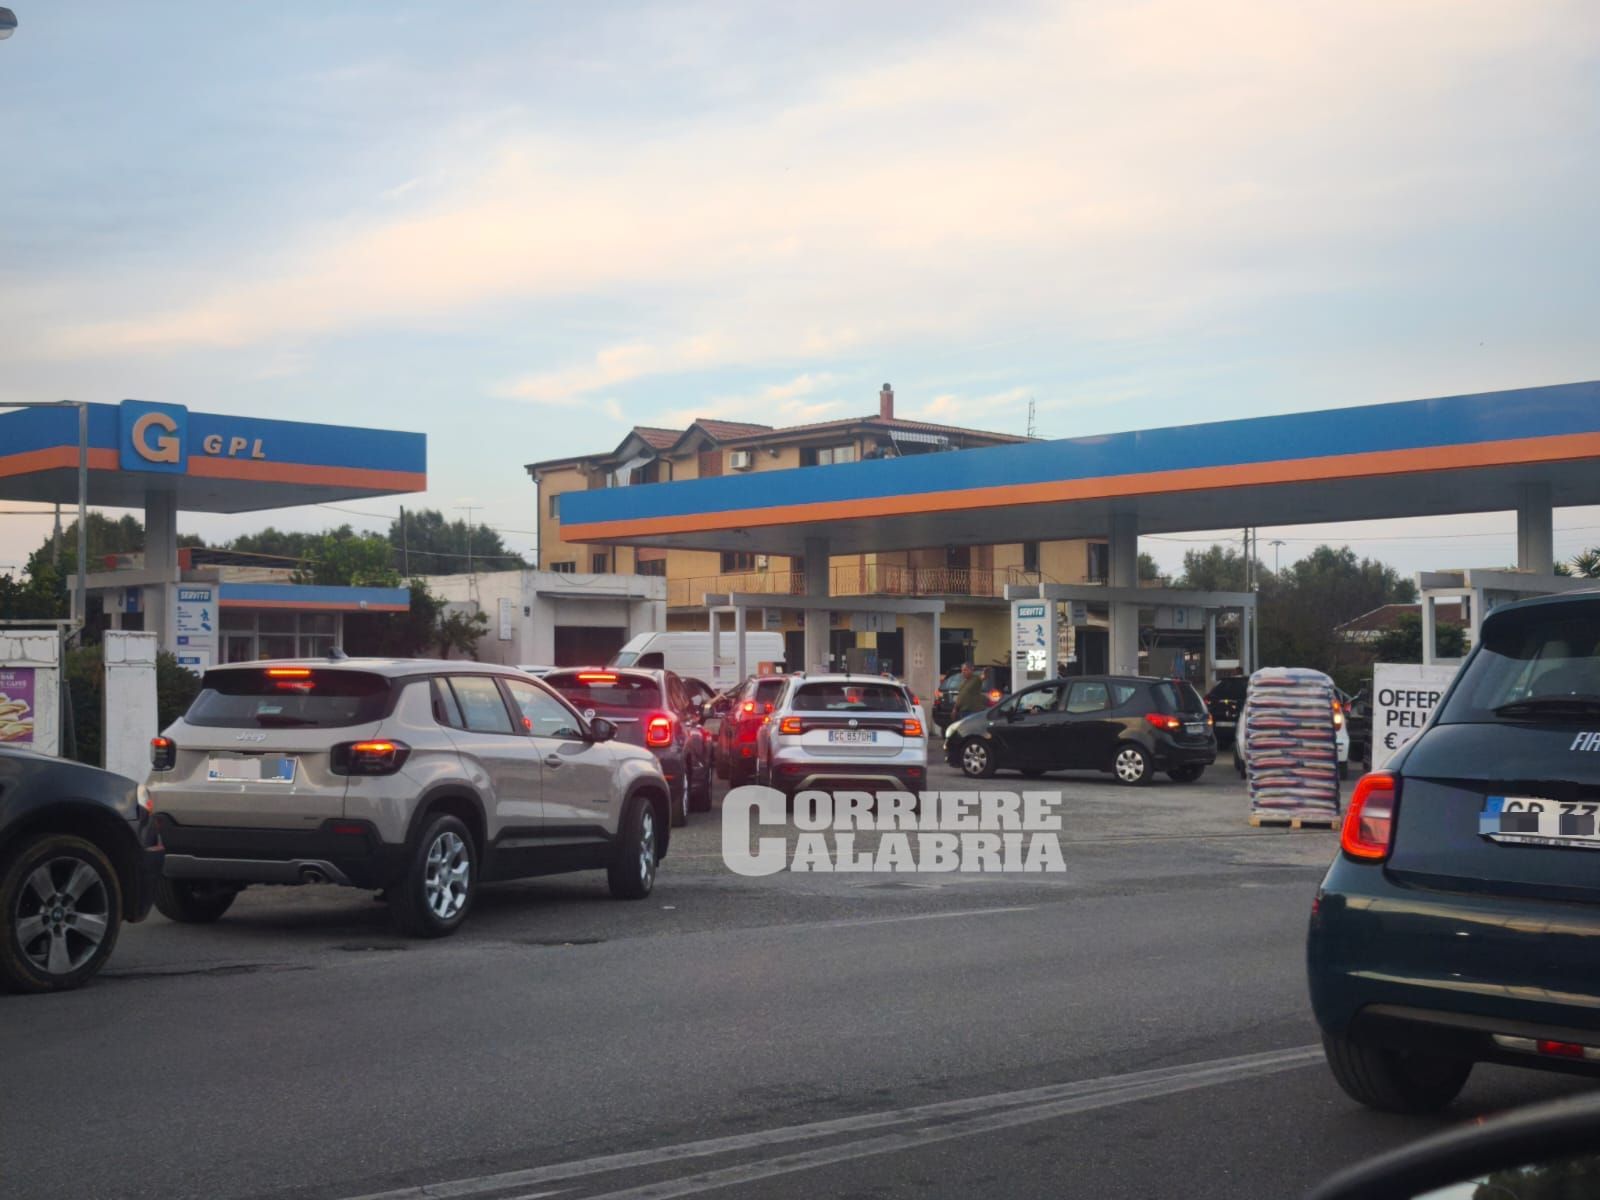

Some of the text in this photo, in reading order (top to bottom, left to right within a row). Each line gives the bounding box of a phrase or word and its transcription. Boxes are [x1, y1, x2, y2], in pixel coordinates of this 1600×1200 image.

[132, 412, 180, 463] G
[203, 434, 266, 458] GPL
[1378, 688, 1444, 709] OFFER
